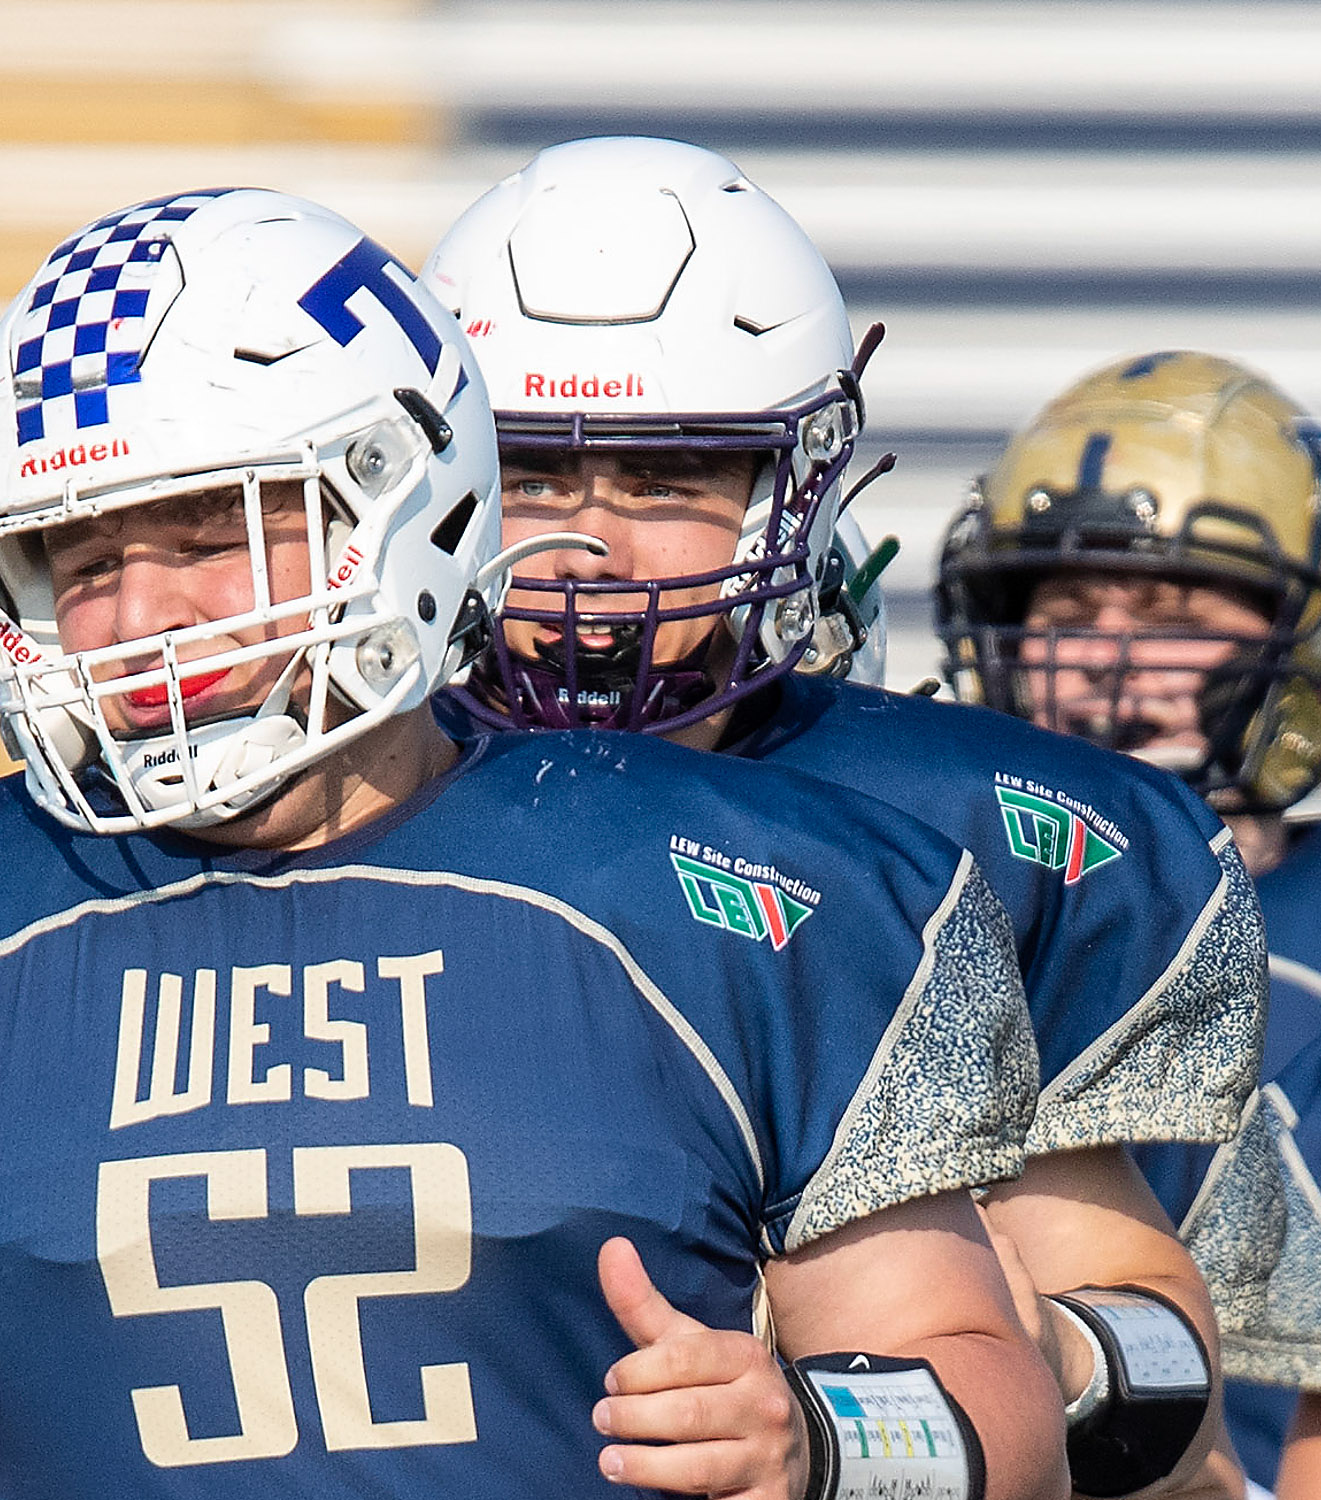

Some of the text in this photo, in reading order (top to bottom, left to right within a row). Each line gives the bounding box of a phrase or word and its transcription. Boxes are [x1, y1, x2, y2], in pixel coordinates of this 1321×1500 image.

[523, 371, 645, 399] Riddell
[558, 686, 621, 706] Rddell
[994, 771, 1130, 850] LEW Site Construction
[669, 834, 822, 905] LEW Site Construction
[109, 949, 444, 1131] WEST
[96, 1142, 478, 1468] 52
